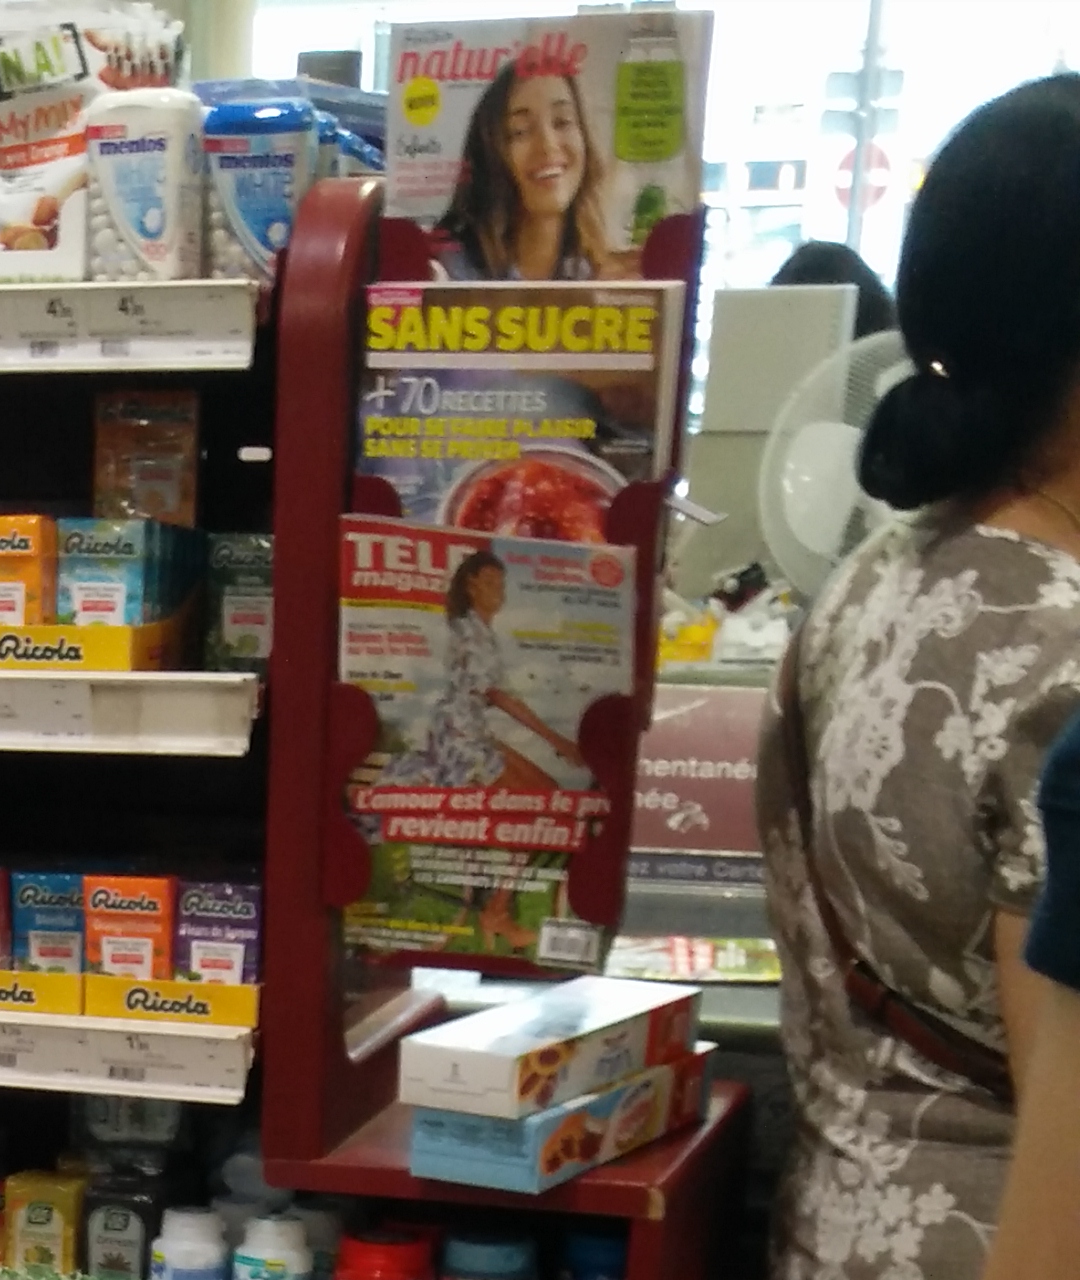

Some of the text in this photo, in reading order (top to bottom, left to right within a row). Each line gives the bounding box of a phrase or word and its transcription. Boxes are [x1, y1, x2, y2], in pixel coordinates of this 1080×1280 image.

[367, 304, 658, 354] SANS SUCRE
[387, 814, 491, 842] revient
[494, 817, 571, 847] enfin
[91, 889, 159, 912] Ricola
[125, 987, 210, 1016] Ricola
